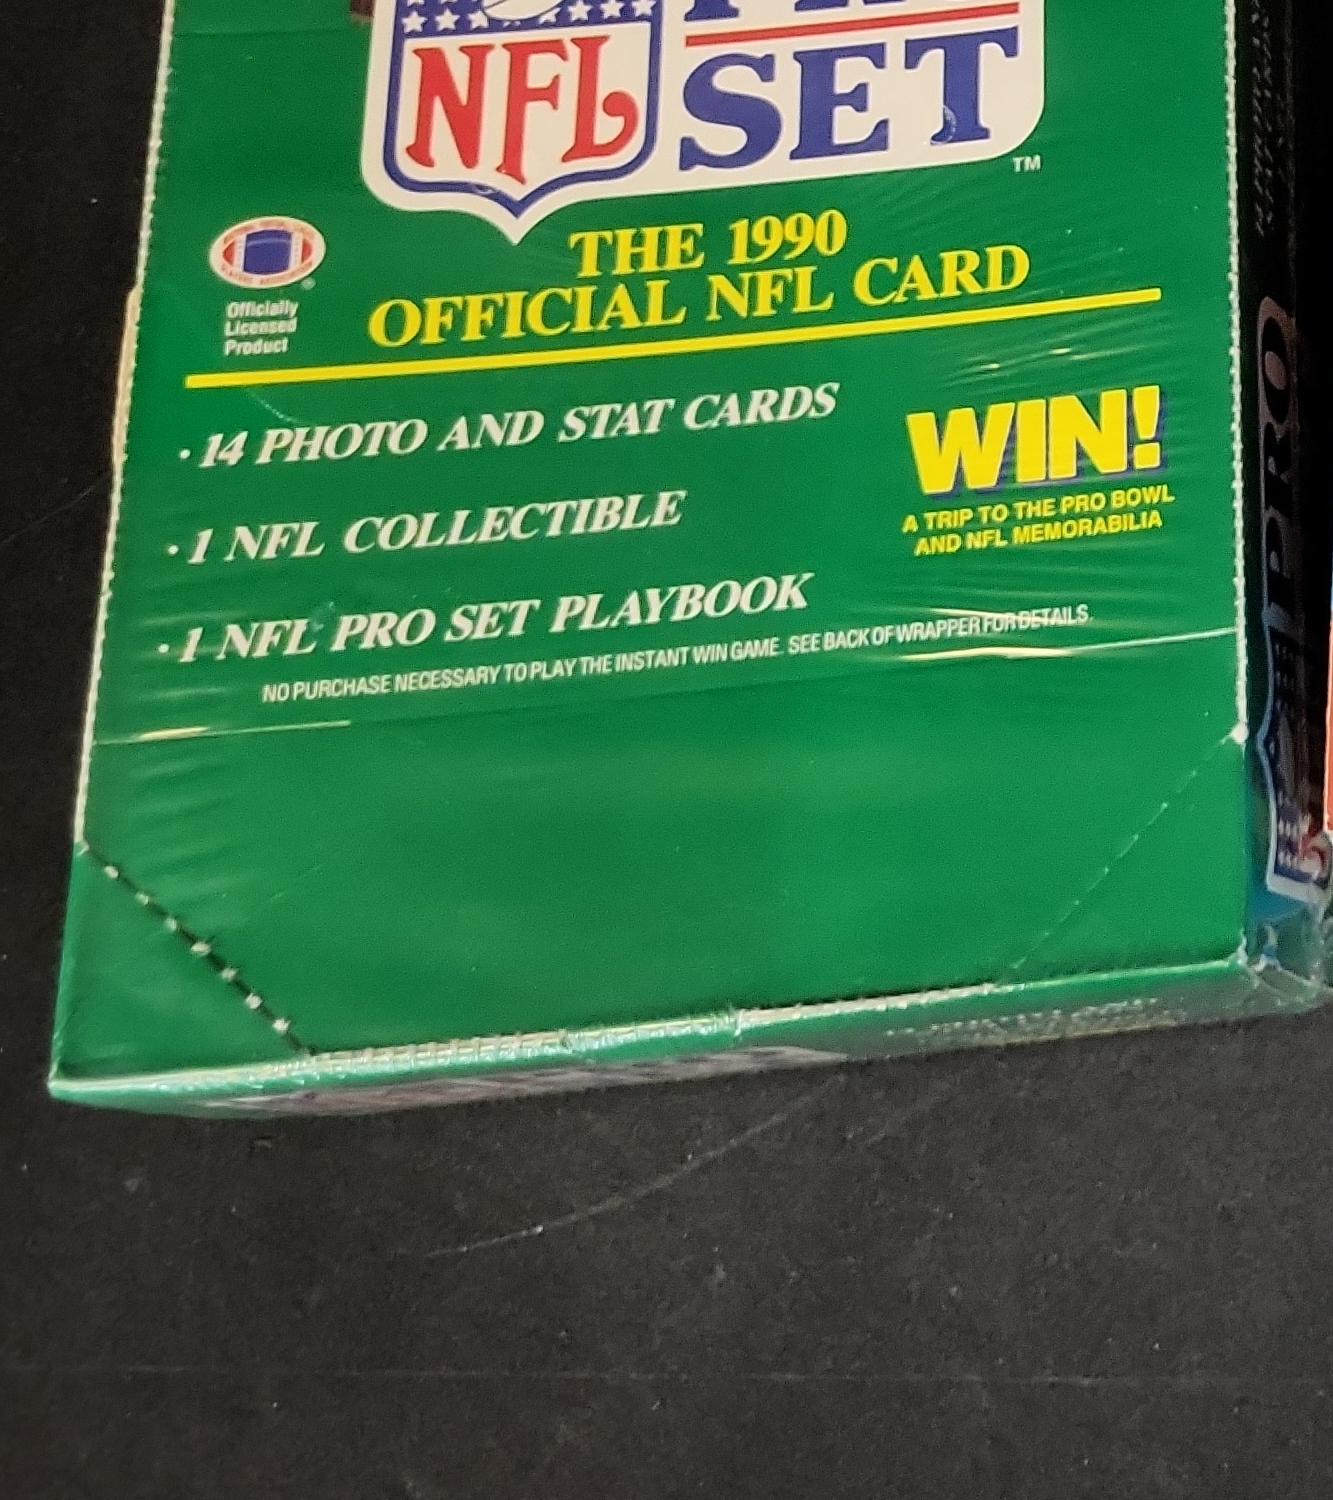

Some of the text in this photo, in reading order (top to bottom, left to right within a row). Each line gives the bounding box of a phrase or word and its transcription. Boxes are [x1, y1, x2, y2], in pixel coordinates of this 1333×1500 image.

[404, 35, 639, 185] NFL
[680, 25, 1020, 172] SET
[1012, 156, 1042, 172] TM
[569, 208, 848, 278] THE 1990
[224, 317, 297, 337] Licensed
[226, 299, 298, 319] Officially
[367, 244, 1030, 348] OFFICIAL NFL CARD
[224, 337, 289, 356] Product
[199, 382, 840, 468] 14 PHOTO AND STAT CARDS
[906, 384, 1162, 497] WIN!
[224, 520, 324, 564] NFL
[343, 490, 687, 555] COLLECTIBLE
[902, 484, 1176, 534] A TRIP TO THE PRO BOWL
[914, 510, 1163, 557] AND NFL MEMORABILIA
[216, 617, 317, 662] NFL
[330, 607, 436, 652] PRO
[444, 598, 540, 643] SET
[550, 571, 816, 633] PLAYBOOK
[262, 683, 290, 703] NO
[293, 674, 391, 701] PURCHASE
[394, 665, 501, 693] NECESSARY
[504, 662, 528, 682] TO
[529, 657, 578, 679] PLAY
[579, 655, 613, 675] THE
[615, 644, 690, 672] INSTANT
[691, 642, 727, 664] WIN
[788, 632, 821, 655] SEE
[823, 627, 870, 650] BACK
[872, 624, 895, 646] OF
[896, 614, 982, 643] WRAPPER
[982, 611, 1016, 633] FOR
